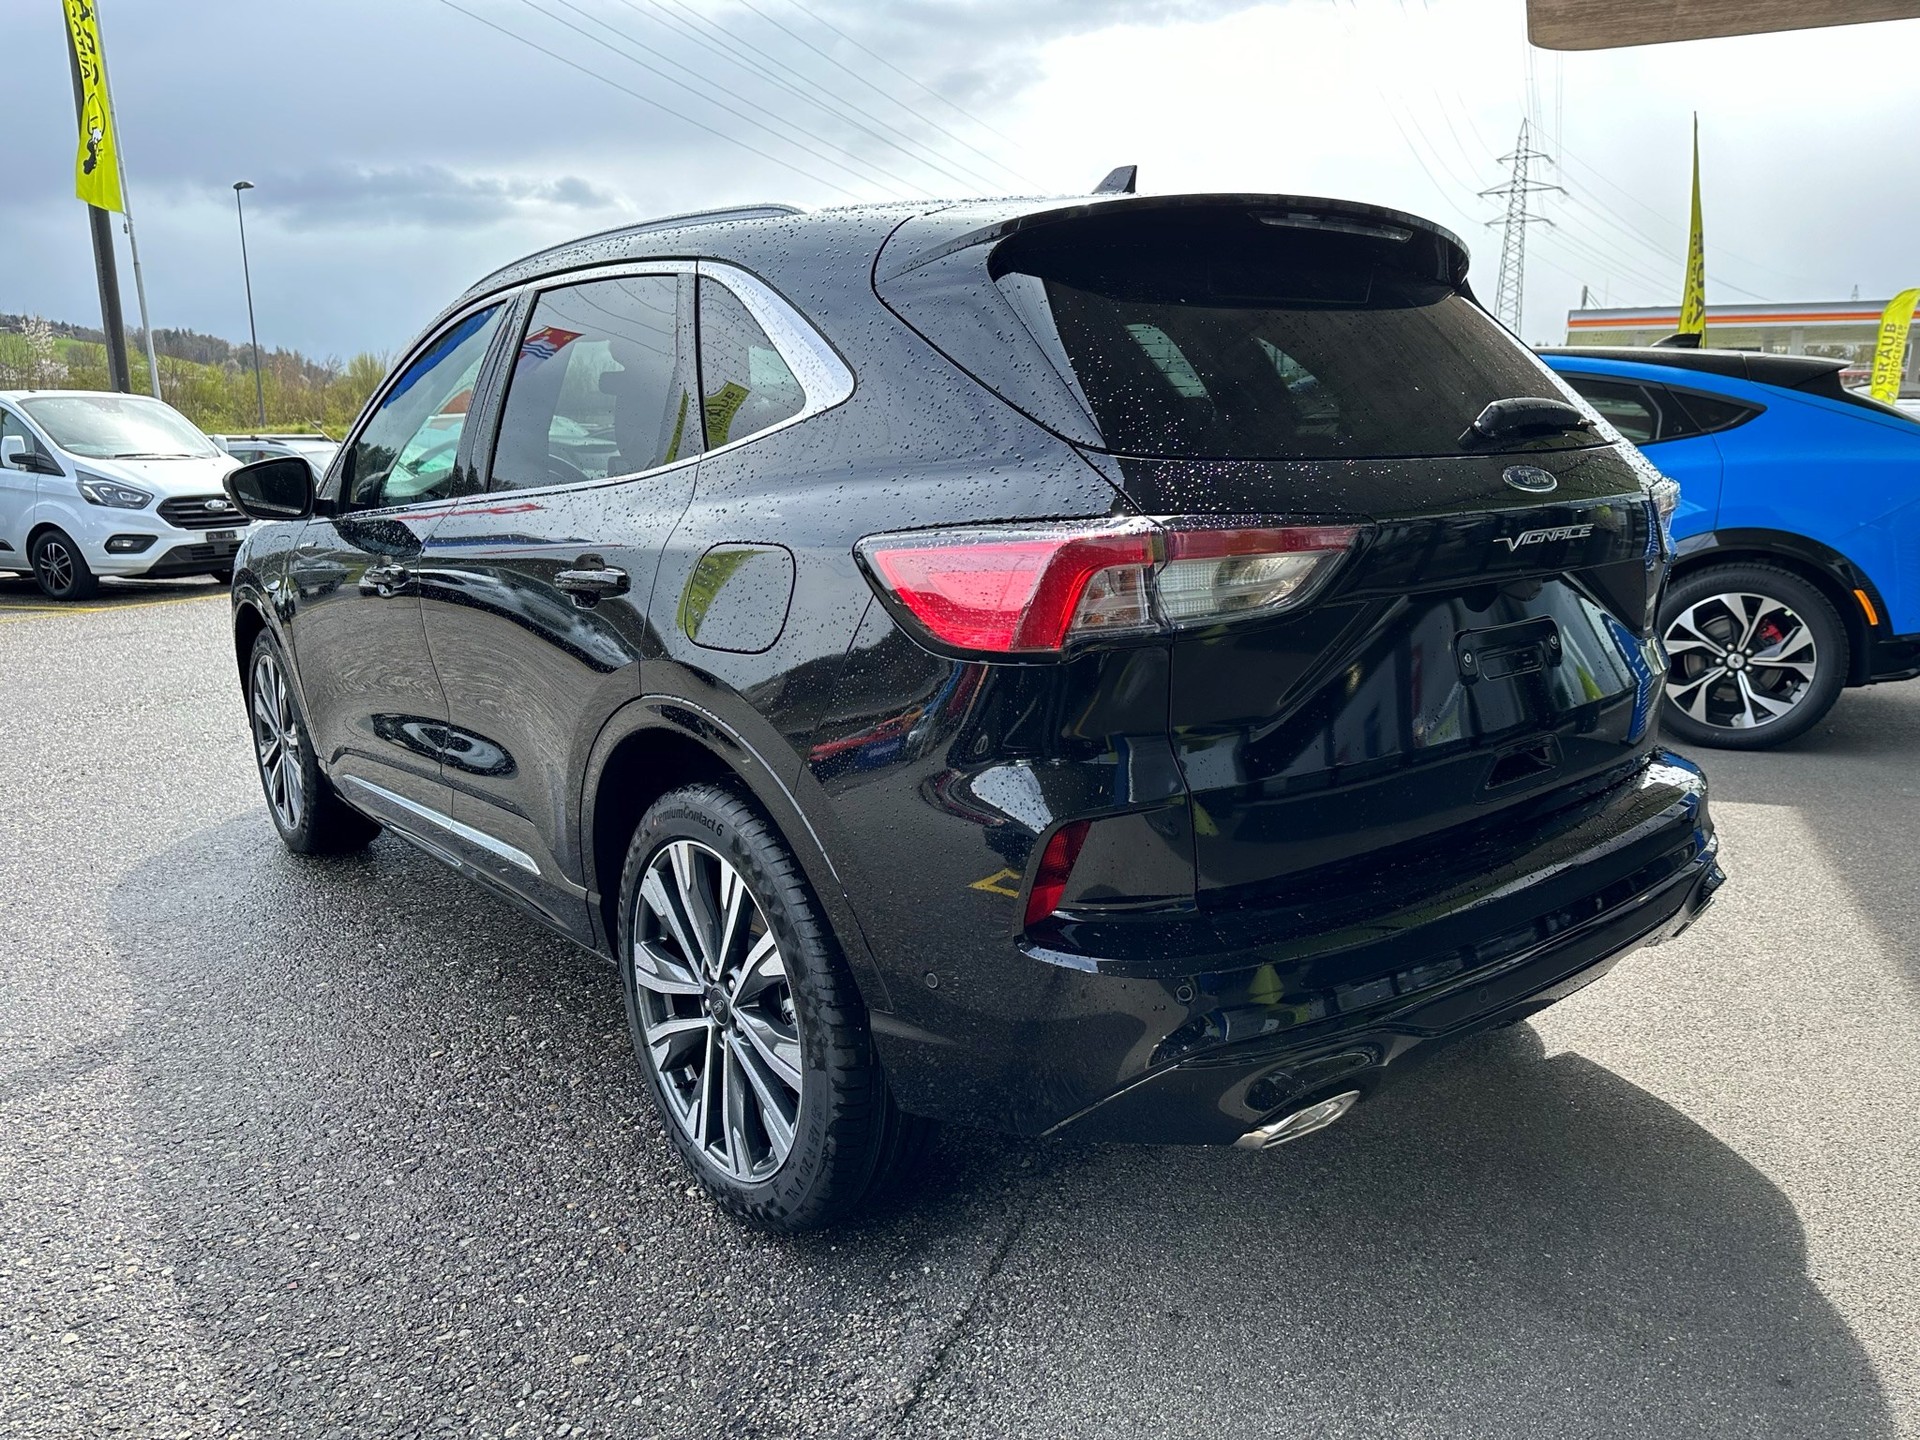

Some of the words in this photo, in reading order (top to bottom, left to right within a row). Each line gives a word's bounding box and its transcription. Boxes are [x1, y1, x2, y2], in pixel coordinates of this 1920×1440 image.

[1875, 323, 1897, 386] GRÄUB
[1518, 469, 1550, 485] Ford
[1492, 523, 1595, 552] VIGNALE
[716, 823, 724, 837] 6
